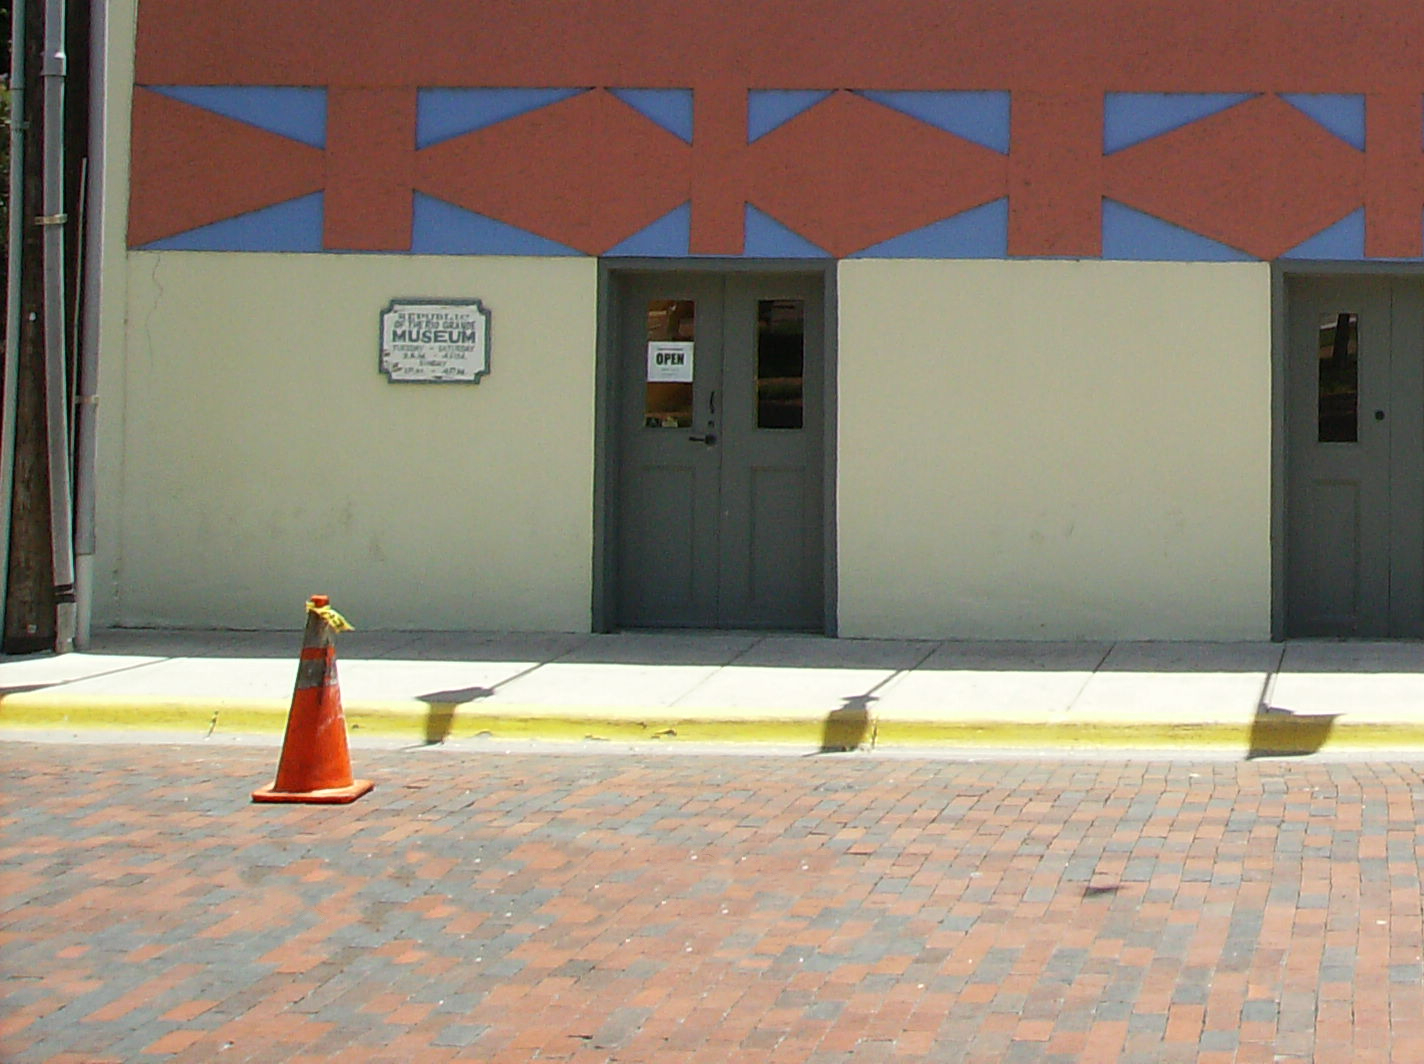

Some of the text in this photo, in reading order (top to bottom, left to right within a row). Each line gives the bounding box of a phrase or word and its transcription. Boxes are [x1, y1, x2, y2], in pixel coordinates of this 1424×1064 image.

[398, 312, 470, 320] REPUBLIC
[394, 321, 476, 329] OF THE RIO GRANDE
[392, 330, 476, 344] MUSEUM
[656, 353, 685, 365] OPEN
